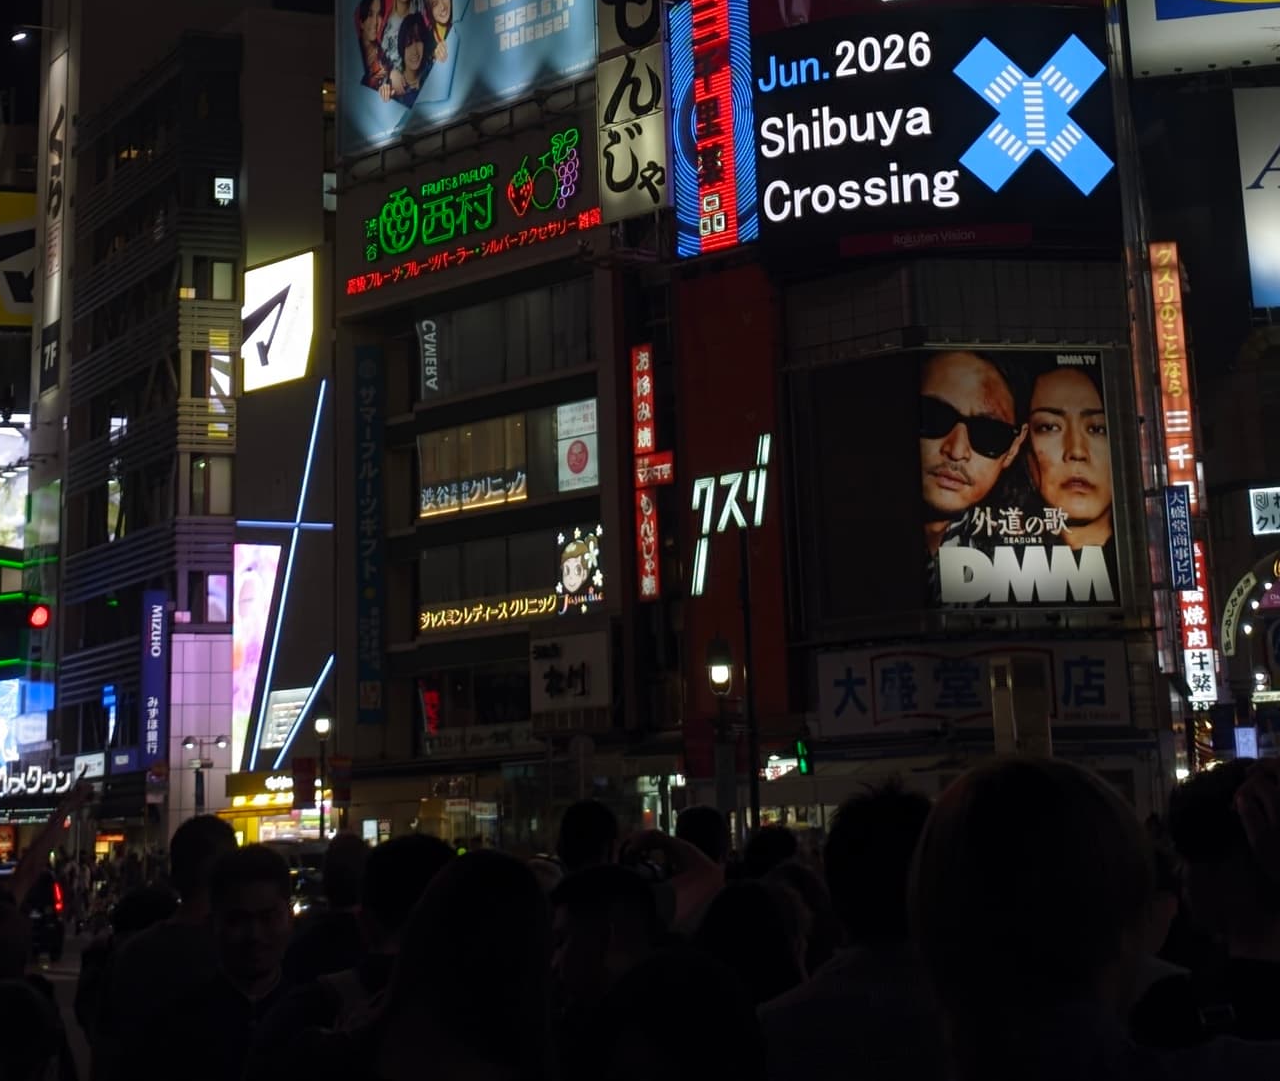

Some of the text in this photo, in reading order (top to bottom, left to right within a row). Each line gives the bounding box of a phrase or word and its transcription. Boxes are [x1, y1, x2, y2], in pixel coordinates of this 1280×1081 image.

[758, 31, 931, 93] Jun. 2026
[760, 105, 931, 159] Shibuya
[422, 183, 494, 246] 西村
[763, 162, 961, 222] Crossing
[44, 341, 58, 373] 7F
[691, 433, 771, 597] クスリ
[970, 506, 1073, 537] 外道の歌
[1169, 492, 1192, 587] 大盛堂商事ビル
[939, 546, 1115, 603] DMM
[151, 604, 163, 657] MIZUHO
[420, 594, 557, 630] ジャスミンレディースクリニック
[833, 655, 1107, 718] 大盛堂店
